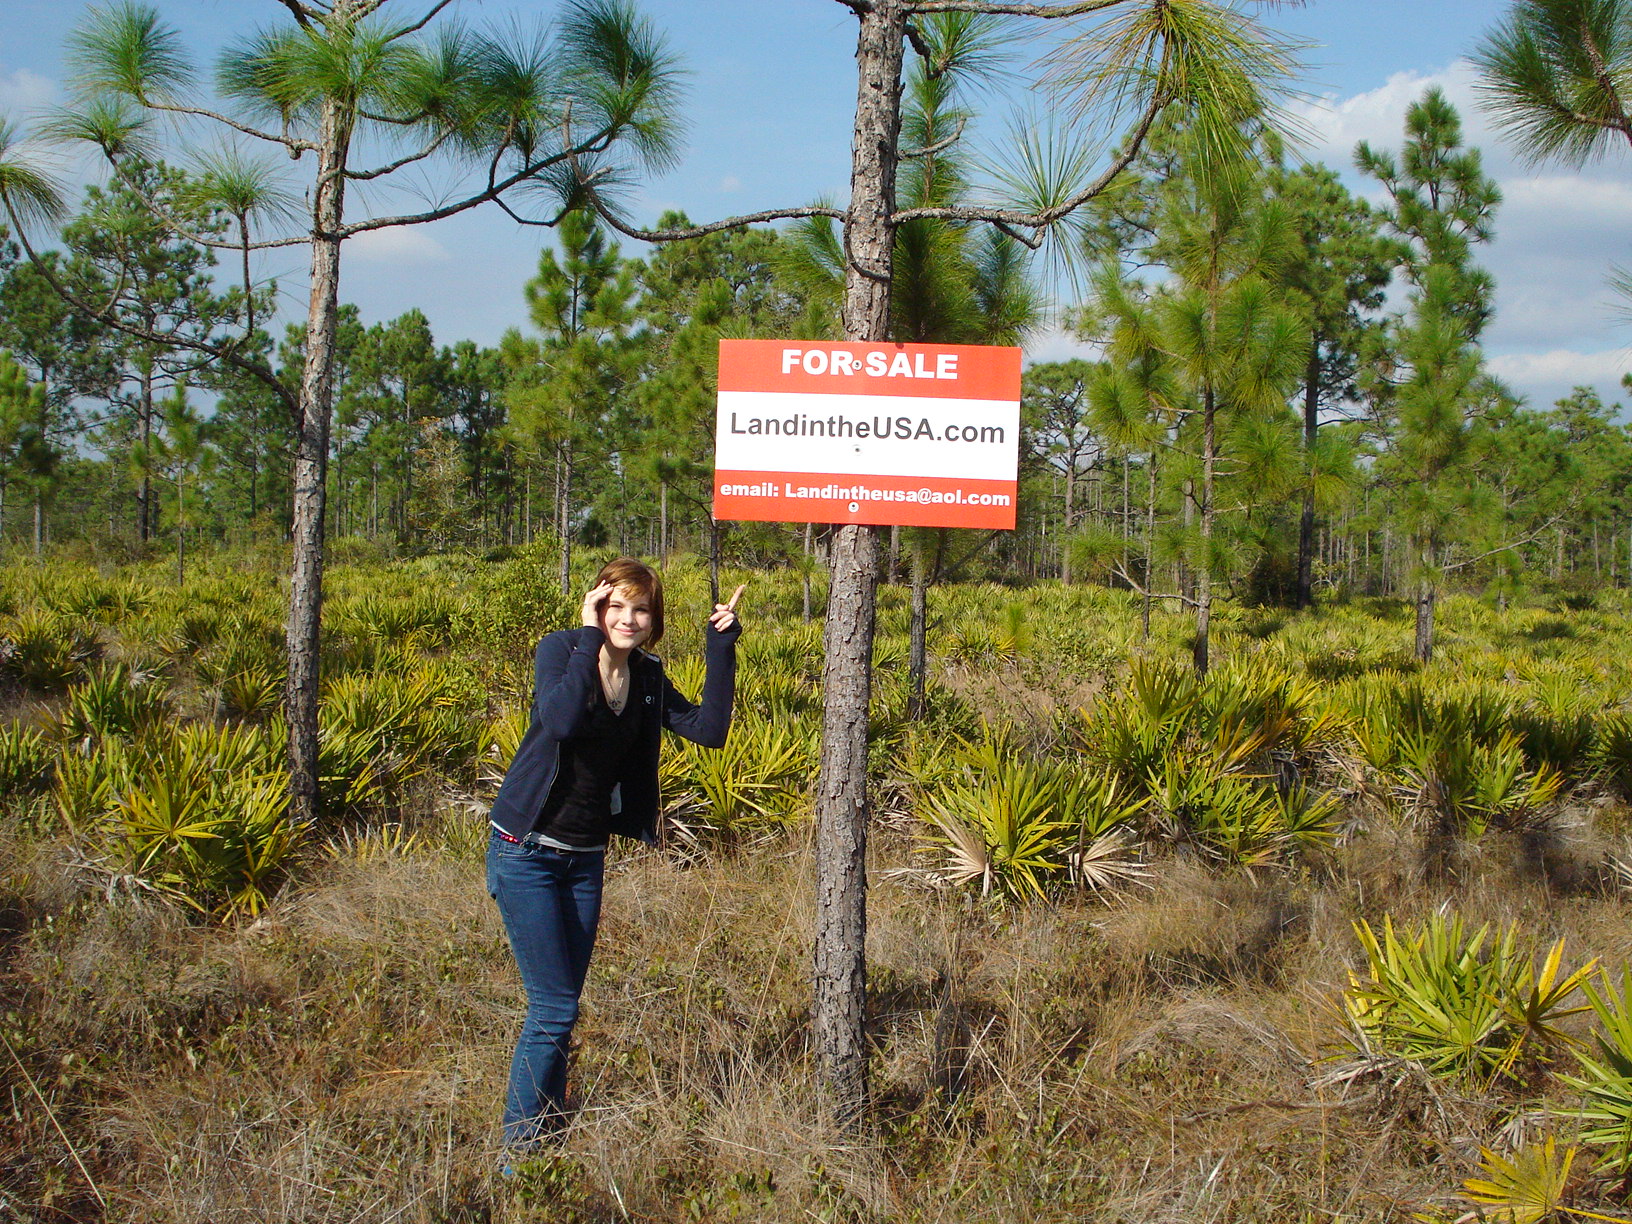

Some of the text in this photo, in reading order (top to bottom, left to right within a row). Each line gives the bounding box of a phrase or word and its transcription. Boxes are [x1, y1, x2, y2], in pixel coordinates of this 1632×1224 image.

[781, 349, 959, 379] FOR SALE
[730, 412, 1005, 443] LandintheUSA.com
[720, 482, 1010, 506] email: Landintheusa@aol.com
